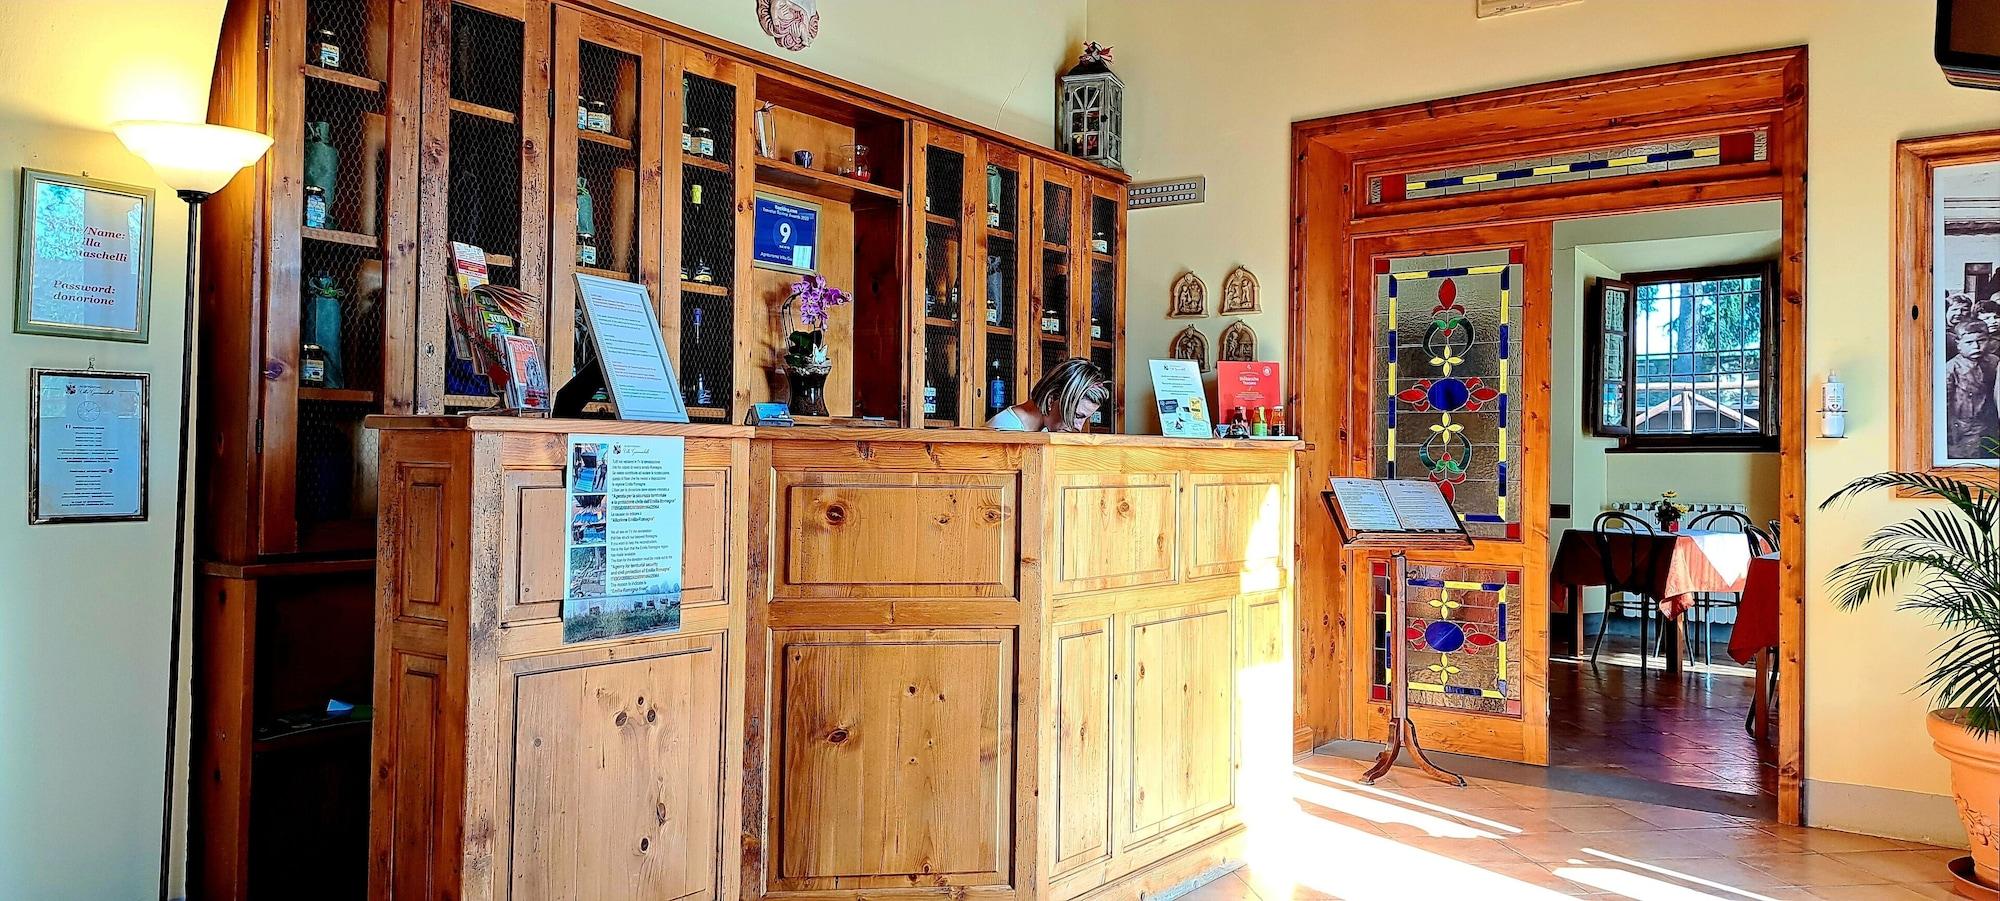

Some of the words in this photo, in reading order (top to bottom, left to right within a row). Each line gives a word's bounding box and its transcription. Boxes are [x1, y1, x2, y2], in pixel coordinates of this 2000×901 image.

[779, 222, 791, 243] 9
[79, 237, 101, 248] illa
[53, 279, 116, 294] Password:
[53, 291, 115, 306] donorione
